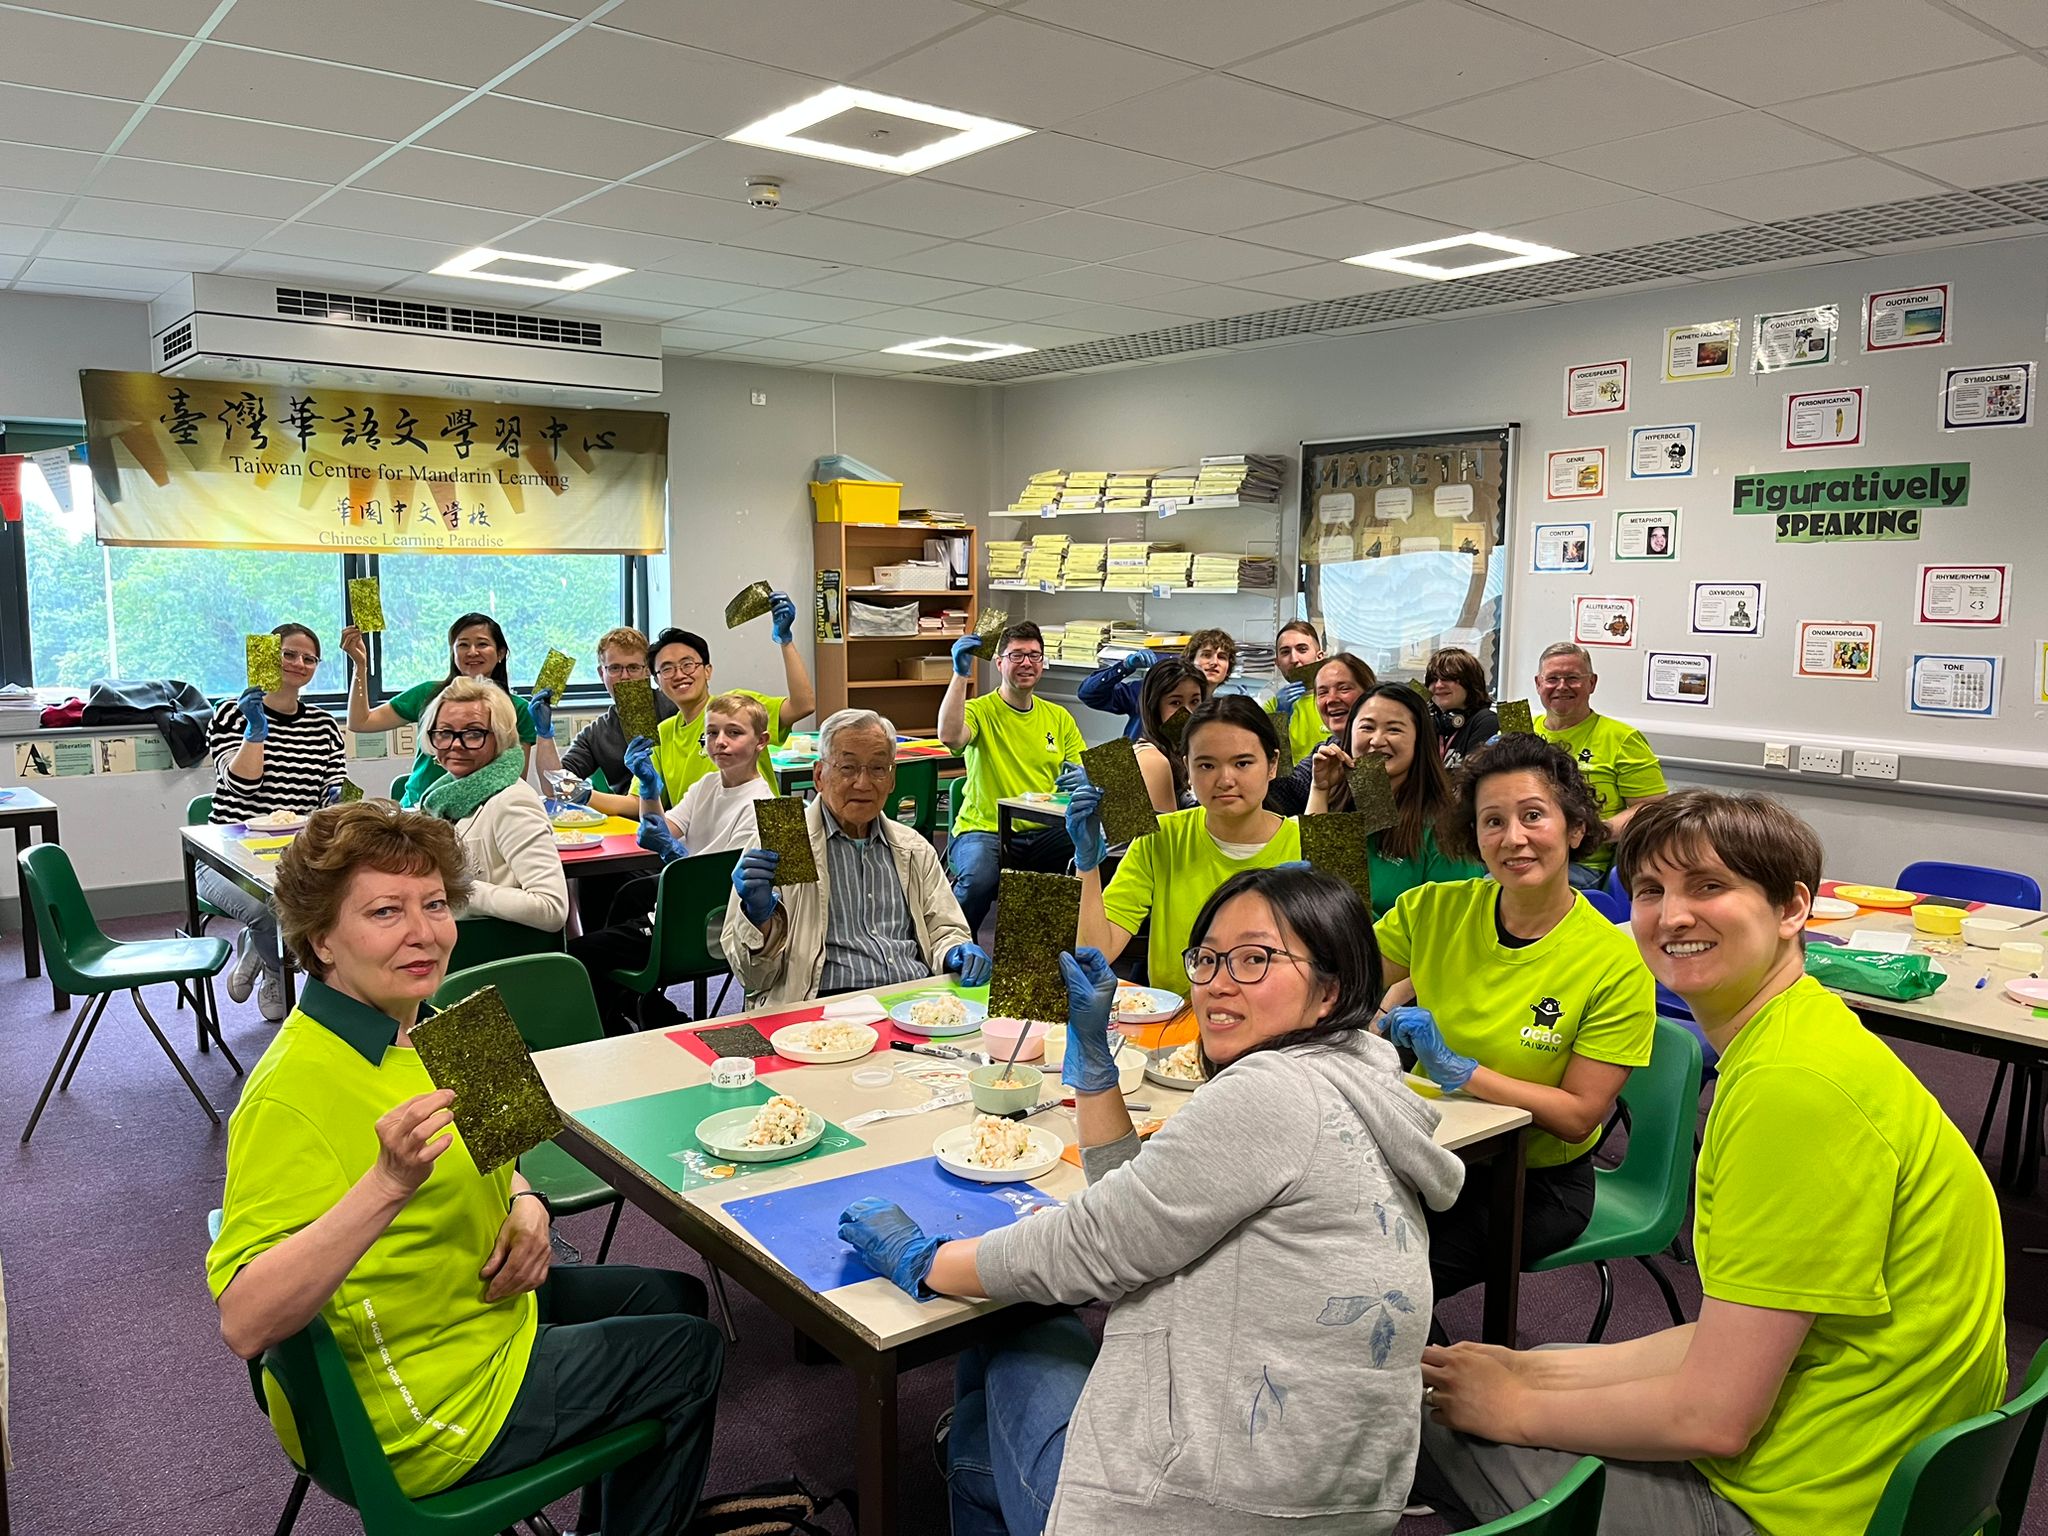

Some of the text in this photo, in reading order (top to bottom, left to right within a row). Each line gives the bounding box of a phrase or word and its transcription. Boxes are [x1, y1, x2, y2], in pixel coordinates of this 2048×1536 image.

[1886, 295, 1929, 307] QUOTATION
[1675, 333, 1700, 341] PATHETIC
[1576, 368, 1618, 379] VOICE/SPEAKER
[1963, 373, 2011, 384] SYMBOLISM
[1797, 396, 1851, 407] PERSONIFICATION
[160, 387, 617, 461] 臺灣華語文學習中心
[1645, 432, 1681, 441] HYPERBOLE
[1566, 456, 1585, 464] GENRE
[229, 455, 569, 491] Taiwan Centre for Mandarin Learning
[1313, 449, 1483, 489] MACBETH
[1733, 467, 1967, 511] Figuratively
[1630, 516, 1662, 524] METAPHOR
[1776, 510, 1919, 537] SPEAKING
[318, 531, 504, 550] Chinese Learning Paradise
[1935, 573, 1990, 581] RHYME/RHYTHM
[1585, 603, 1625, 611] ALLITERATION
[1811, 629, 1864, 637] ONOMATOPOEIA
[1656, 658, 1702, 667] FORESHADOWING
[1943, 663, 1964, 671] TONE
[55, 742, 91, 750] alliteration
[1520, 1039, 1559, 1053] TAIWAN
[363, 1298, 376, 1320] ocac
[387, 1365, 402, 1386] ocac
[399, 1385, 415, 1408] ocac
